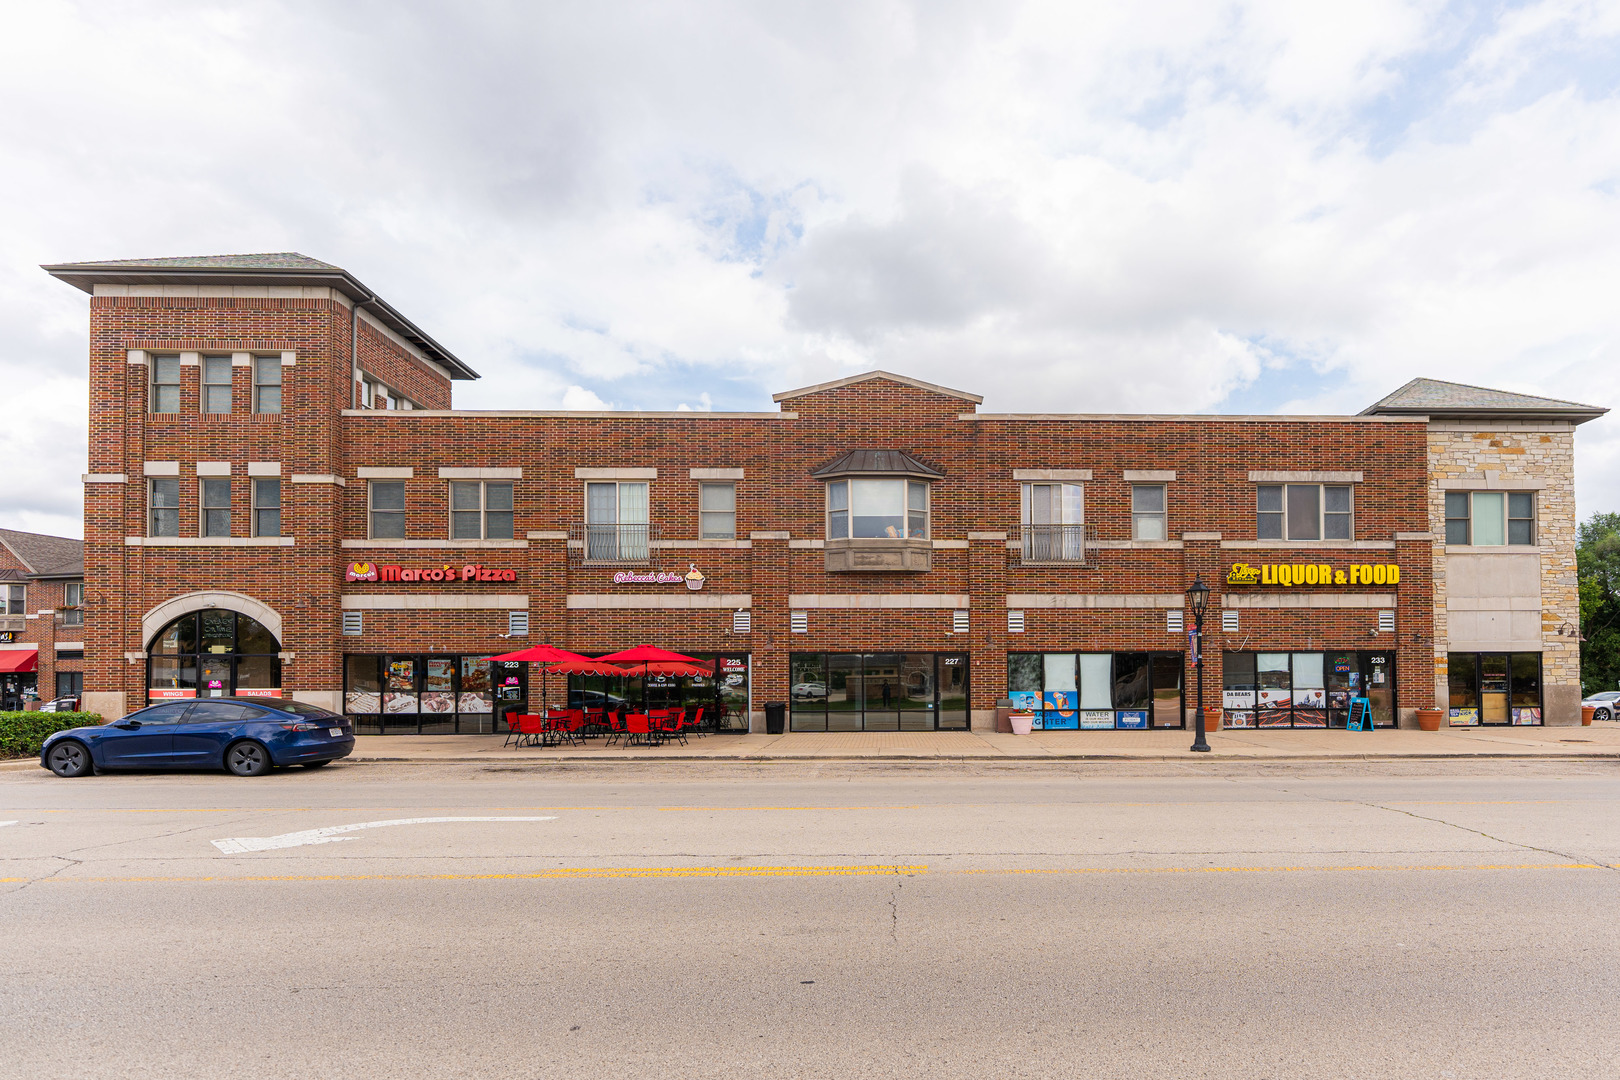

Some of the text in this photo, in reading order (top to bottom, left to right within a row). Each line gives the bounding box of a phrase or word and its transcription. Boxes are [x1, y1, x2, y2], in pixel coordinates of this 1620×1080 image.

[381, 564, 517, 582] Marco's Pizza
[614, 571, 684, 583] Rebecca's Cakes
[1262, 564, 1400, 586] LIQUOR & FOOD
